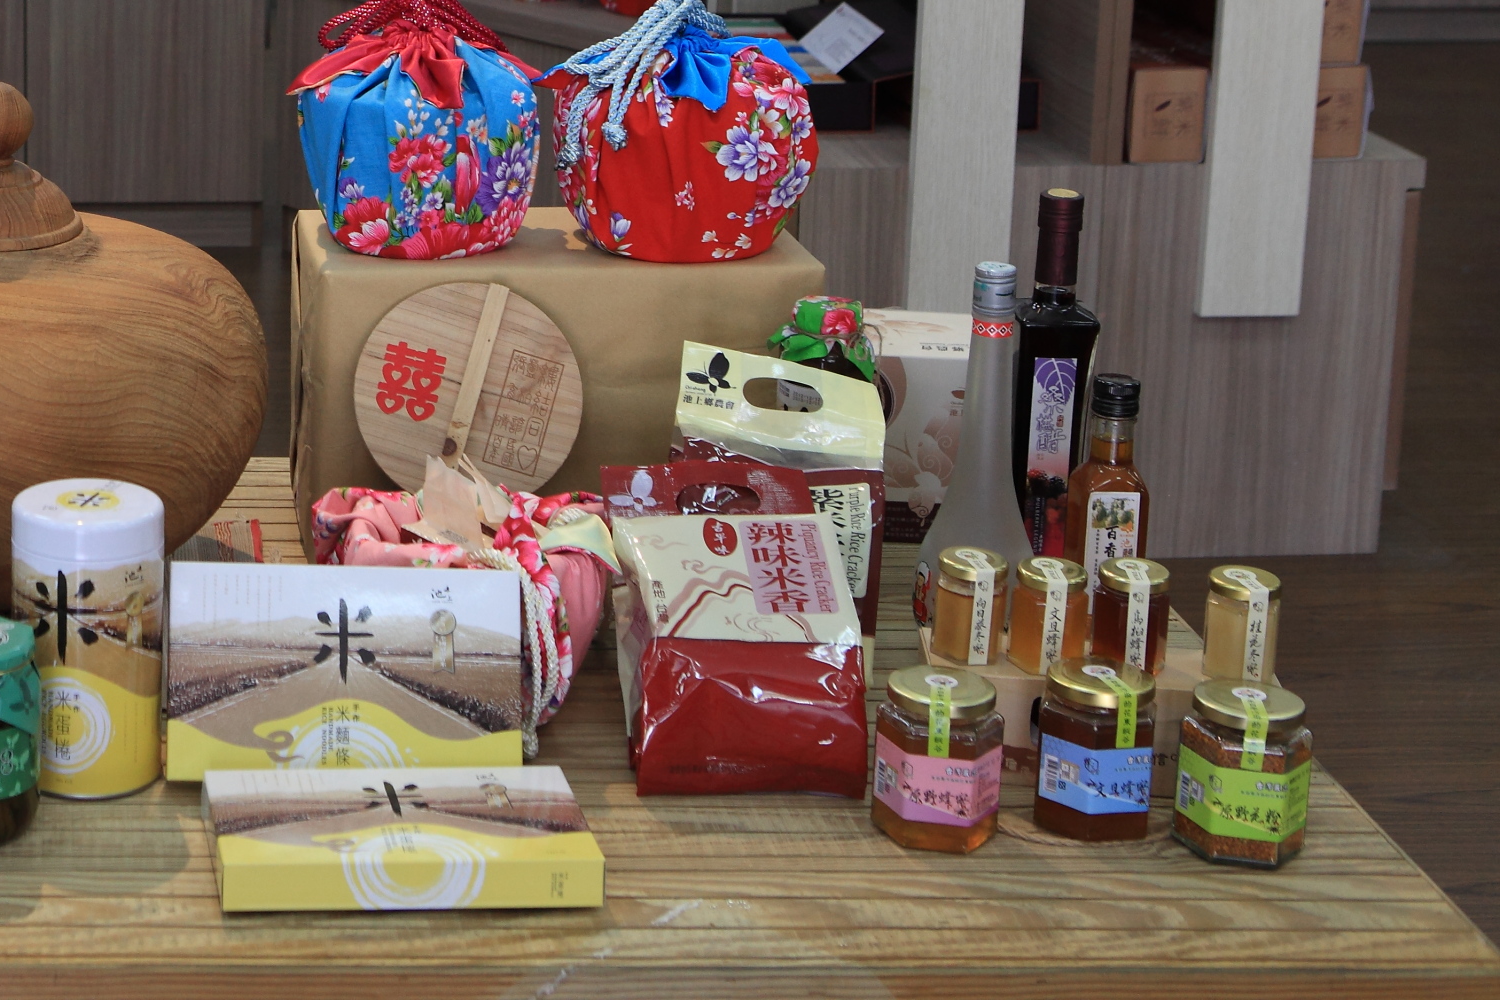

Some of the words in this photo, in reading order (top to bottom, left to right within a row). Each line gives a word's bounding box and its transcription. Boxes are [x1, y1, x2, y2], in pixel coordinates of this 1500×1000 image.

[683, 394, 735, 410] 池上鄉農會
[850, 512, 865, 530] Rice
[711, 521, 729, 555] 古早味
[849, 532, 866, 553] Rice
[748, 522, 807, 613] 辣味米香
[810, 561, 826, 579] Rice
[846, 554, 863, 594] Cracker
[814, 580, 833, 613] Cracker
[336, 705, 350, 767] 米麵條
